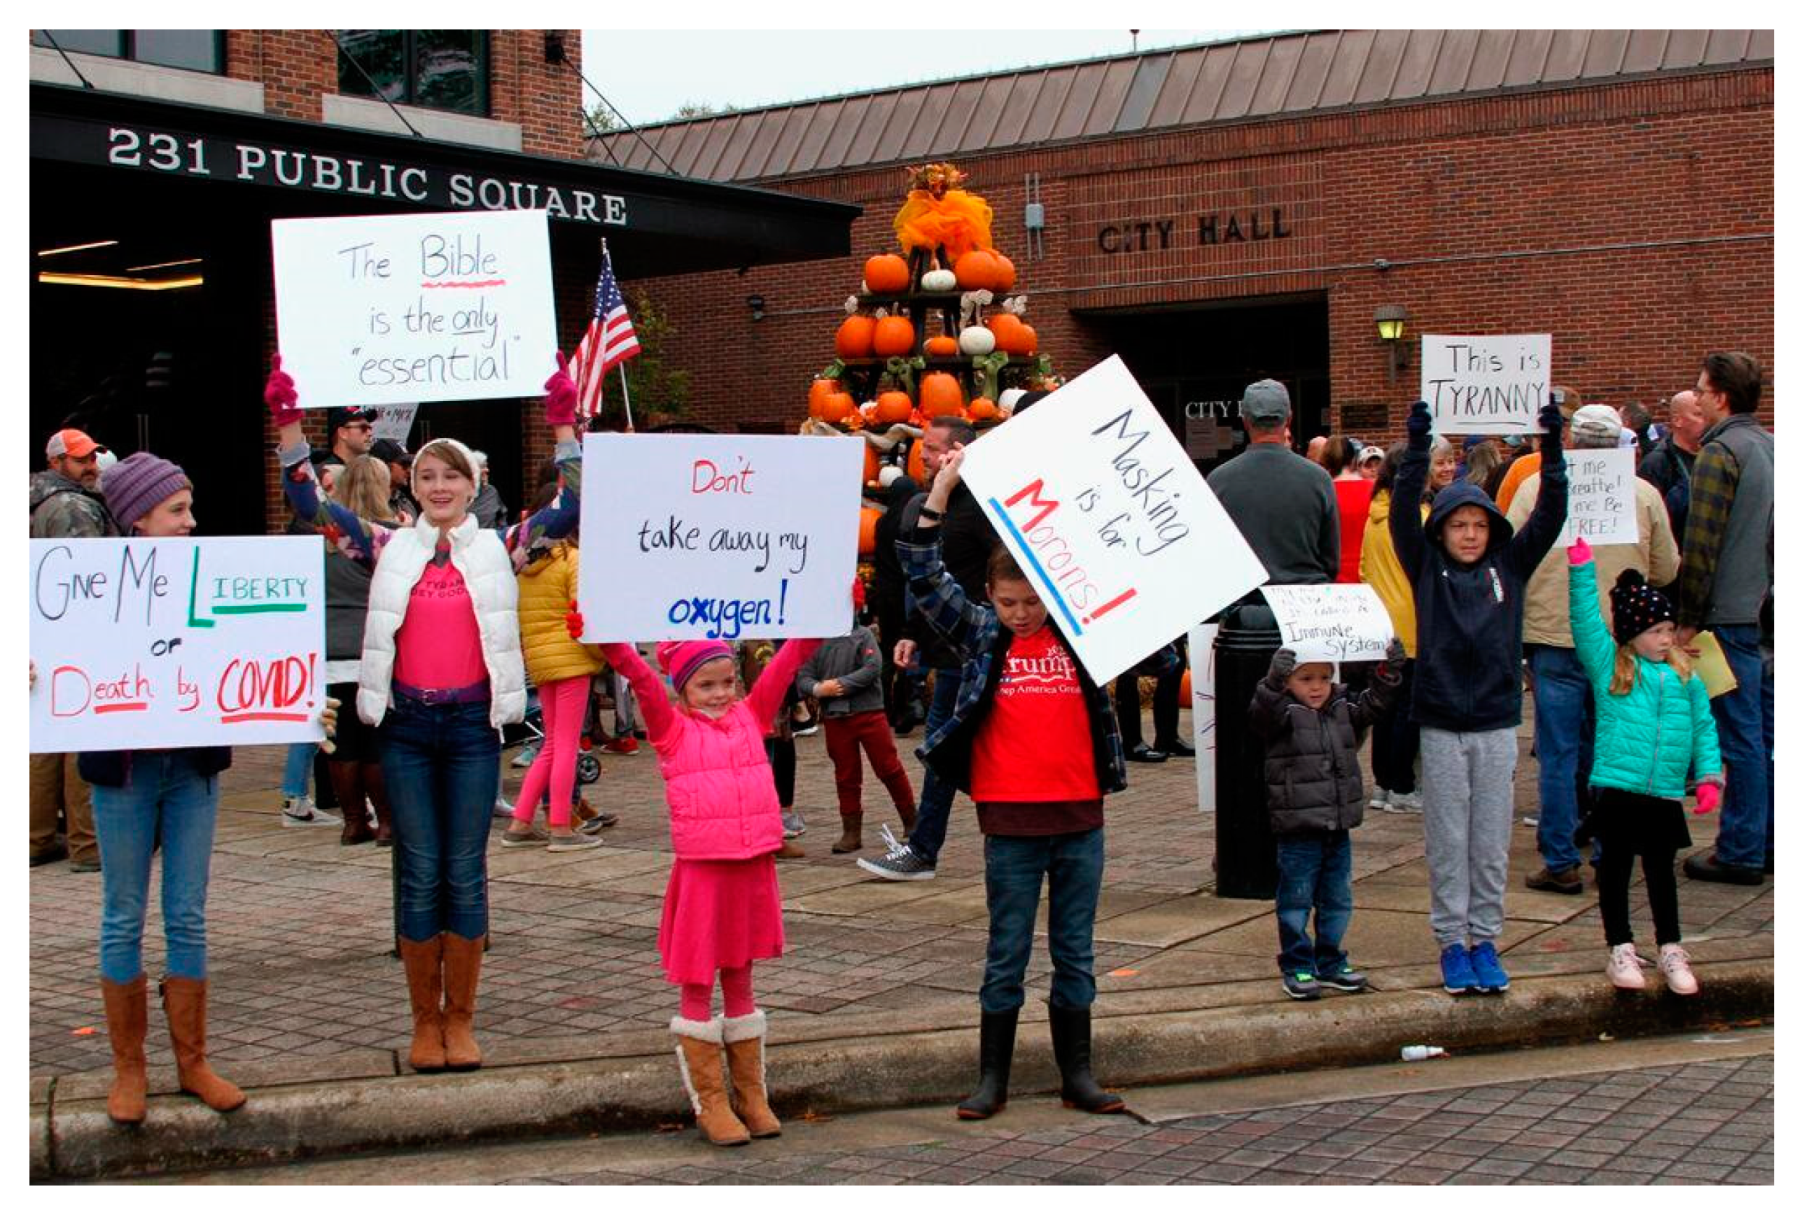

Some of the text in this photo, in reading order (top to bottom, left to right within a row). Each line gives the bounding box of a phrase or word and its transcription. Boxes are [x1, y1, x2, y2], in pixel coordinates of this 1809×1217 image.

[108, 127, 628, 227] 231 PUBLIC SQUARE
[1099, 207, 1293, 253] CITY HALL
[338, 233, 499, 279] The Bible
[369, 295, 499, 348] is the only
[1445, 344, 1540, 373] This is
[1185, 400, 1232, 418] CITY
[1428, 379, 1545, 418] TYRANNY
[691, 455, 756, 494] Don't
[1091, 408, 1190, 556] Masking
[1583, 460, 1606, 475] me
[1075, 484, 1131, 548] is for
[1568, 516, 1617, 537] FREE!
[638, 515, 809, 574] take away my
[1004, 477, 1138, 625] Morons!
[115, 544, 168, 627] Me
[668, 578, 788, 639] oxygen!
[151, 637, 182, 656] or
[52, 653, 317, 717] Death by COVID!
